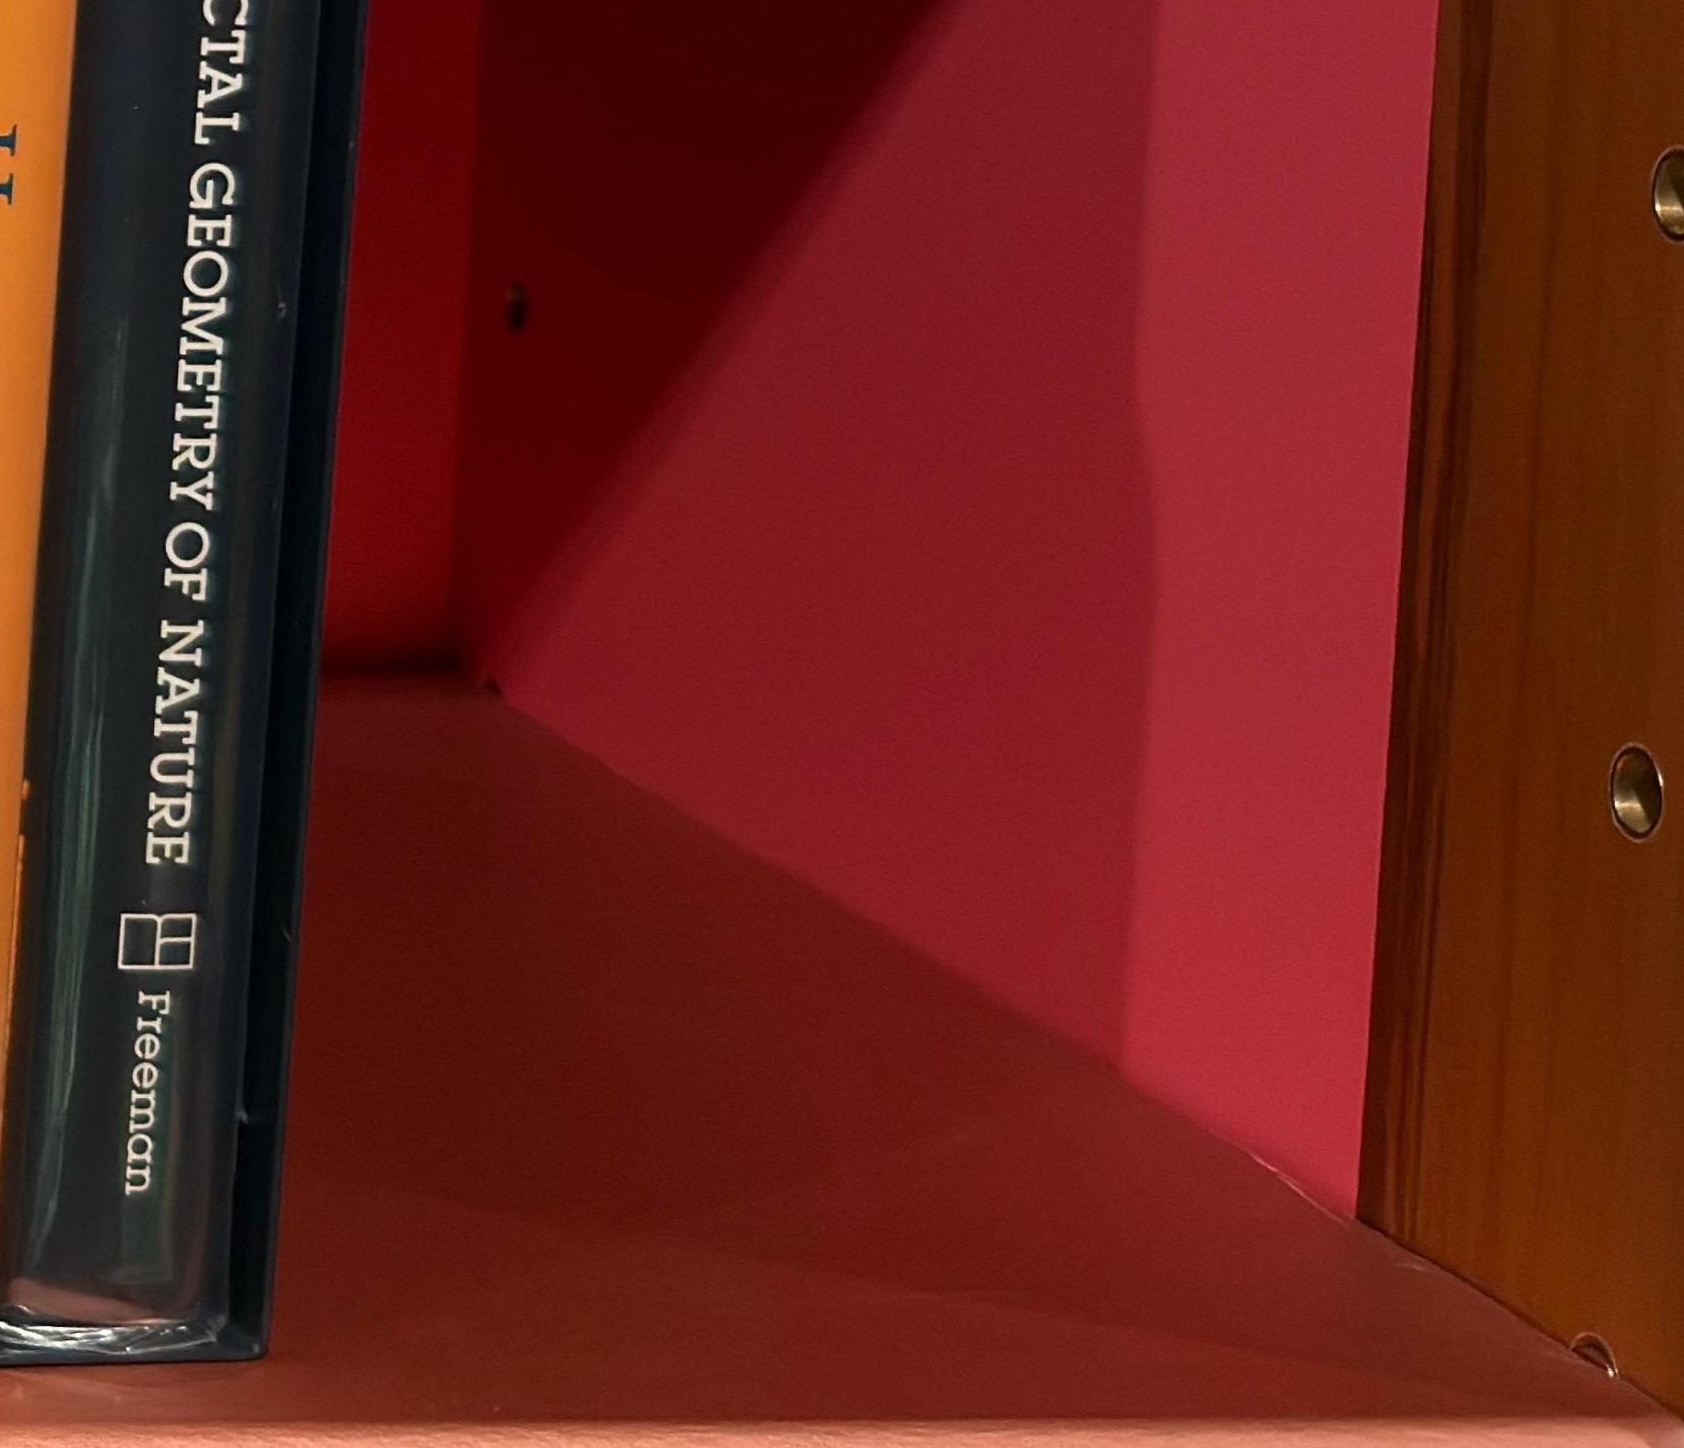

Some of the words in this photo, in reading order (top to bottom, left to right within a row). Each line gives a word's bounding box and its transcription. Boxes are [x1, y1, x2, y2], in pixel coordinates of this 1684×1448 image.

[170, 163, 235, 510] GEOMETRY
[164, 522, 210, 601] OF
[146, 620, 204, 864] NATURE
[125, 991, 170, 1195] Freeman
